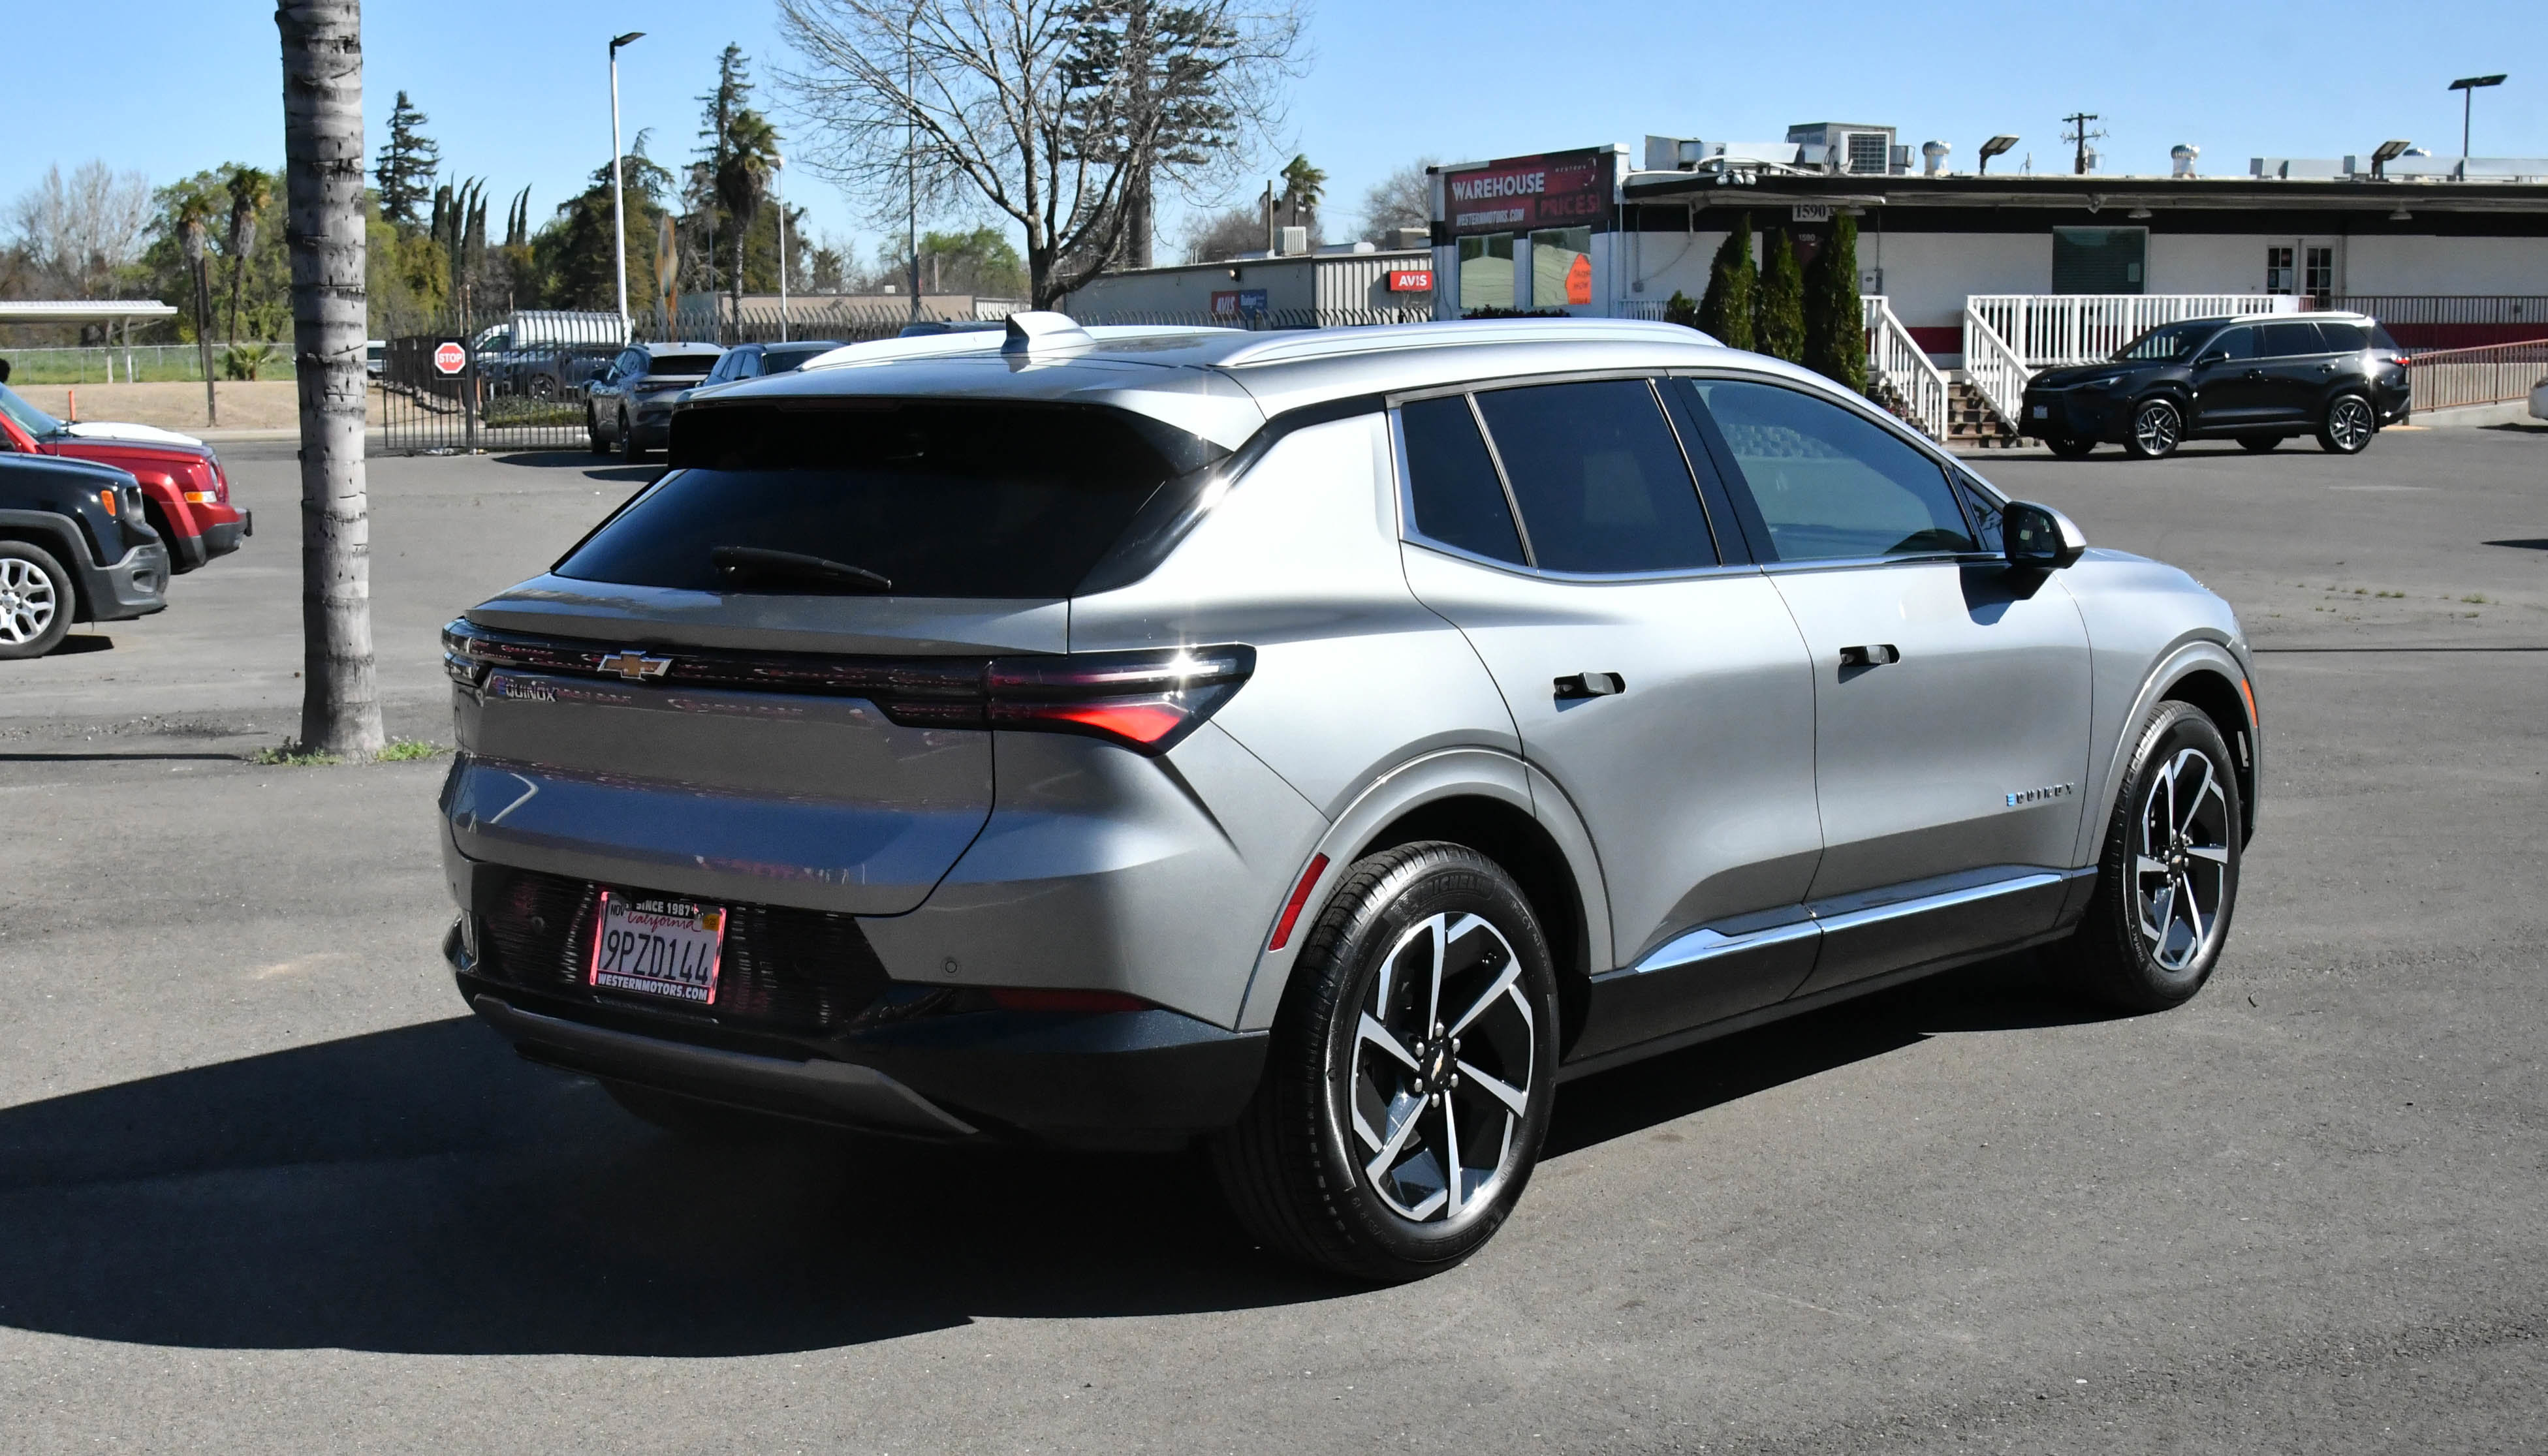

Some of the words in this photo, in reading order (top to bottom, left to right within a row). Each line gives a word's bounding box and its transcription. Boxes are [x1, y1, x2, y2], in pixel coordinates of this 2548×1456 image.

[1452, 172, 1545, 201] WAREHOUSE
[1794, 203, 1826, 218] 1590
[1398, 274, 1426, 287] AVIS
[1217, 296, 1236, 313] AVIS
[438, 353, 462, 364] STOP
[610, 904, 625, 916] NOV
[636, 900, 664, 913] SINCE
[667, 903, 690, 916] 1987
[627, 910, 701, 933] California
[603, 929, 708, 984] 9PZD144
[598, 972, 708, 1000] WESTERNMOTORS.COM
